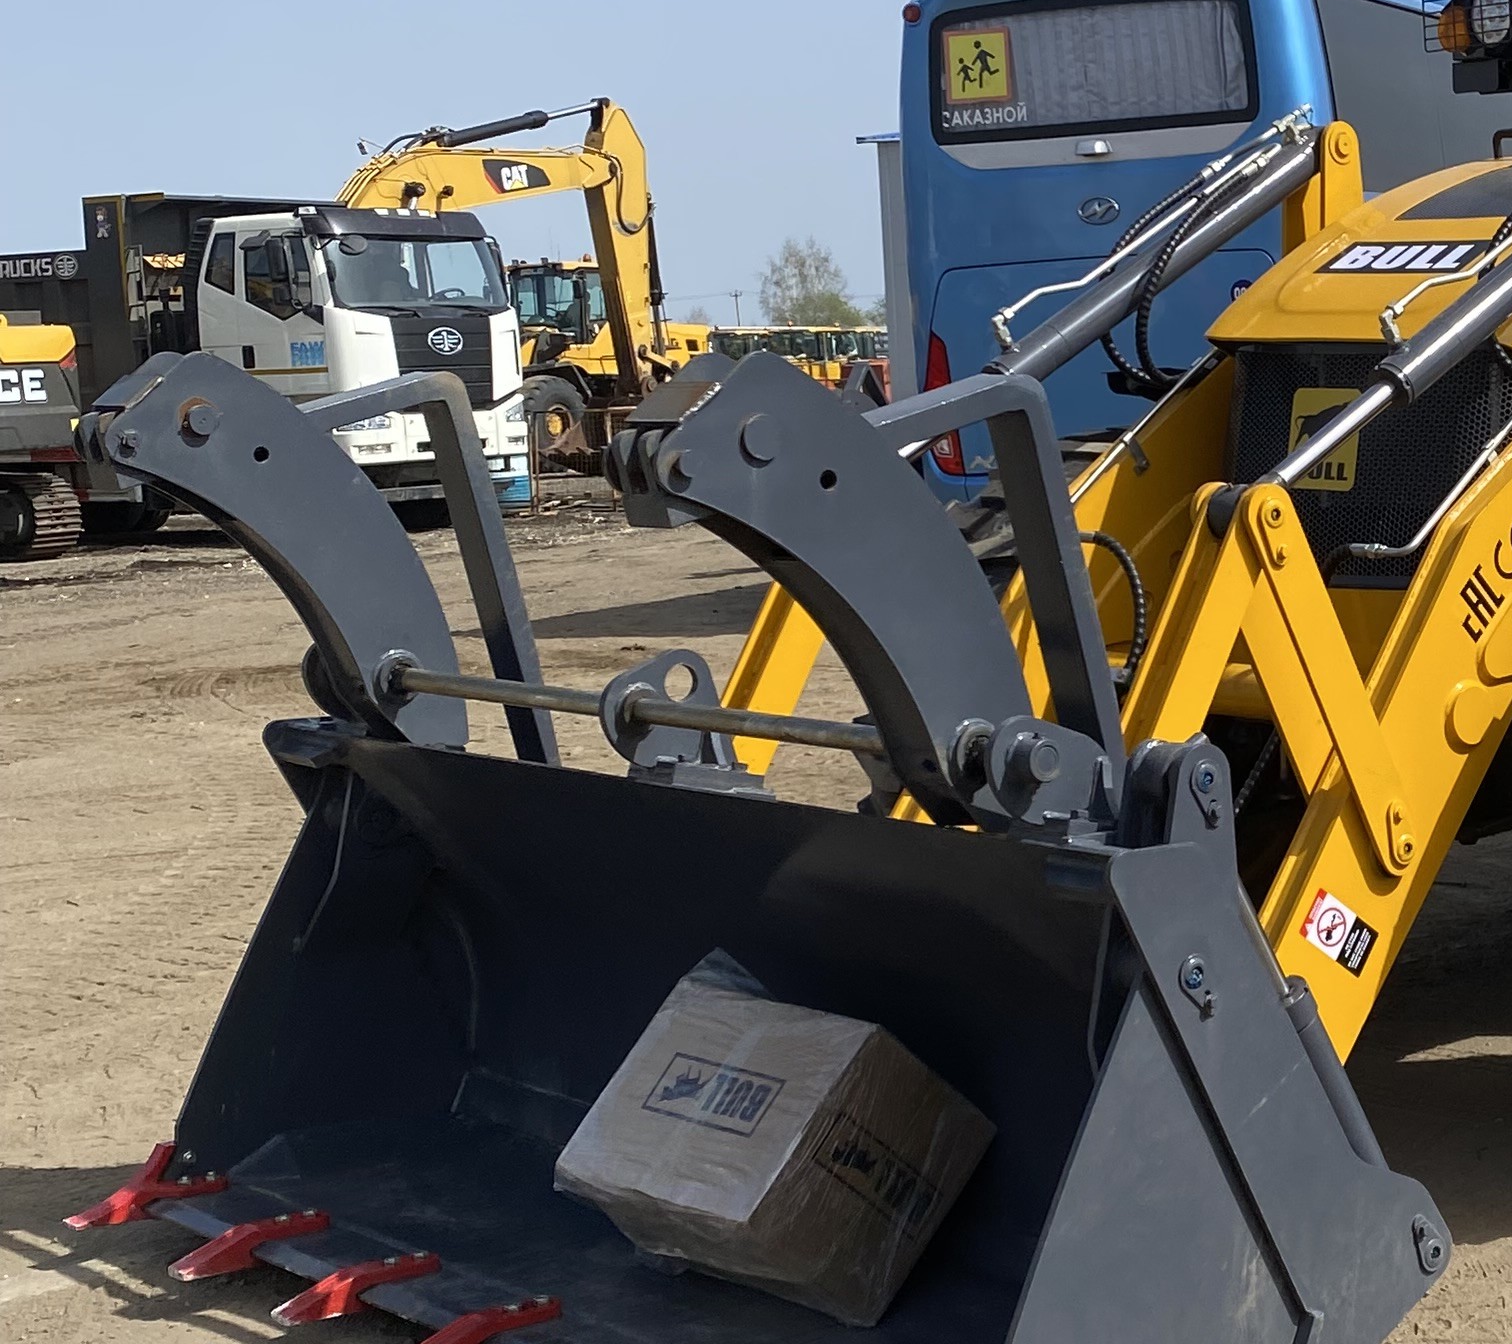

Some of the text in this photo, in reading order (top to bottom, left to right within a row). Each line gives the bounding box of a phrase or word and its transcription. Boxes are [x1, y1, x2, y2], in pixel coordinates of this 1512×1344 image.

[500, 164, 529, 191] CAT
[1328, 244, 1476, 270] BULL
[1306, 459, 1349, 482] ULL
[700, 1073, 773, 1123] BULL
